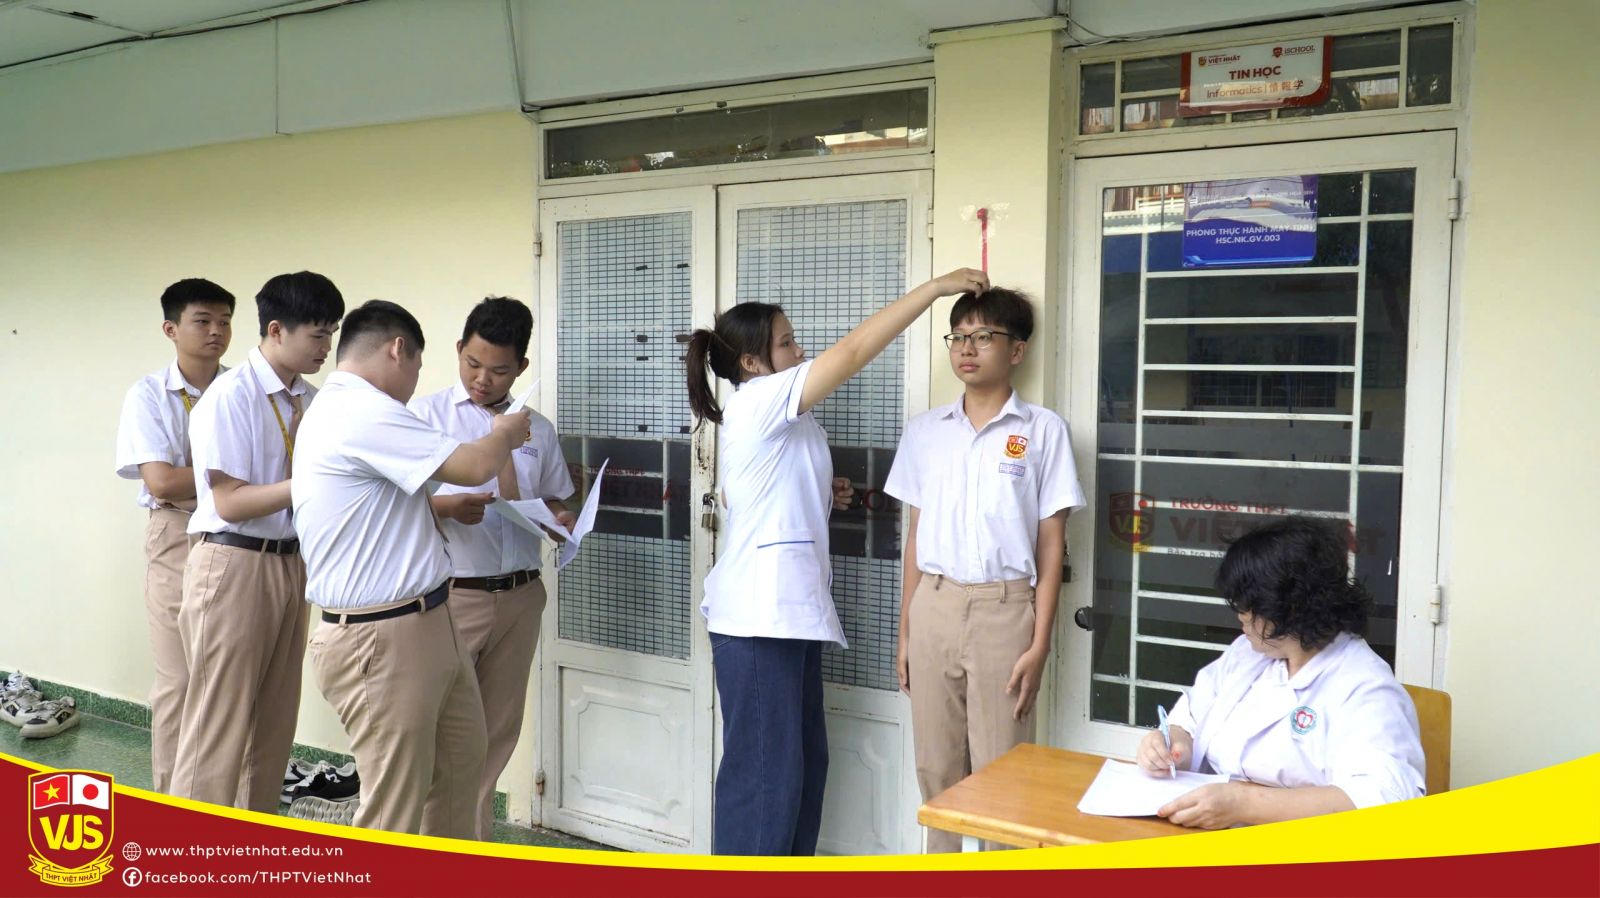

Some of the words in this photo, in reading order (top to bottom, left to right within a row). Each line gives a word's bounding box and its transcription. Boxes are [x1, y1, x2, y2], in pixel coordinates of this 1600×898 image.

[1229, 69, 1250, 80] TIN
[1253, 65, 1282, 79] HỌC
[1215, 234, 1281, 244] HSC.NK.GV.003
